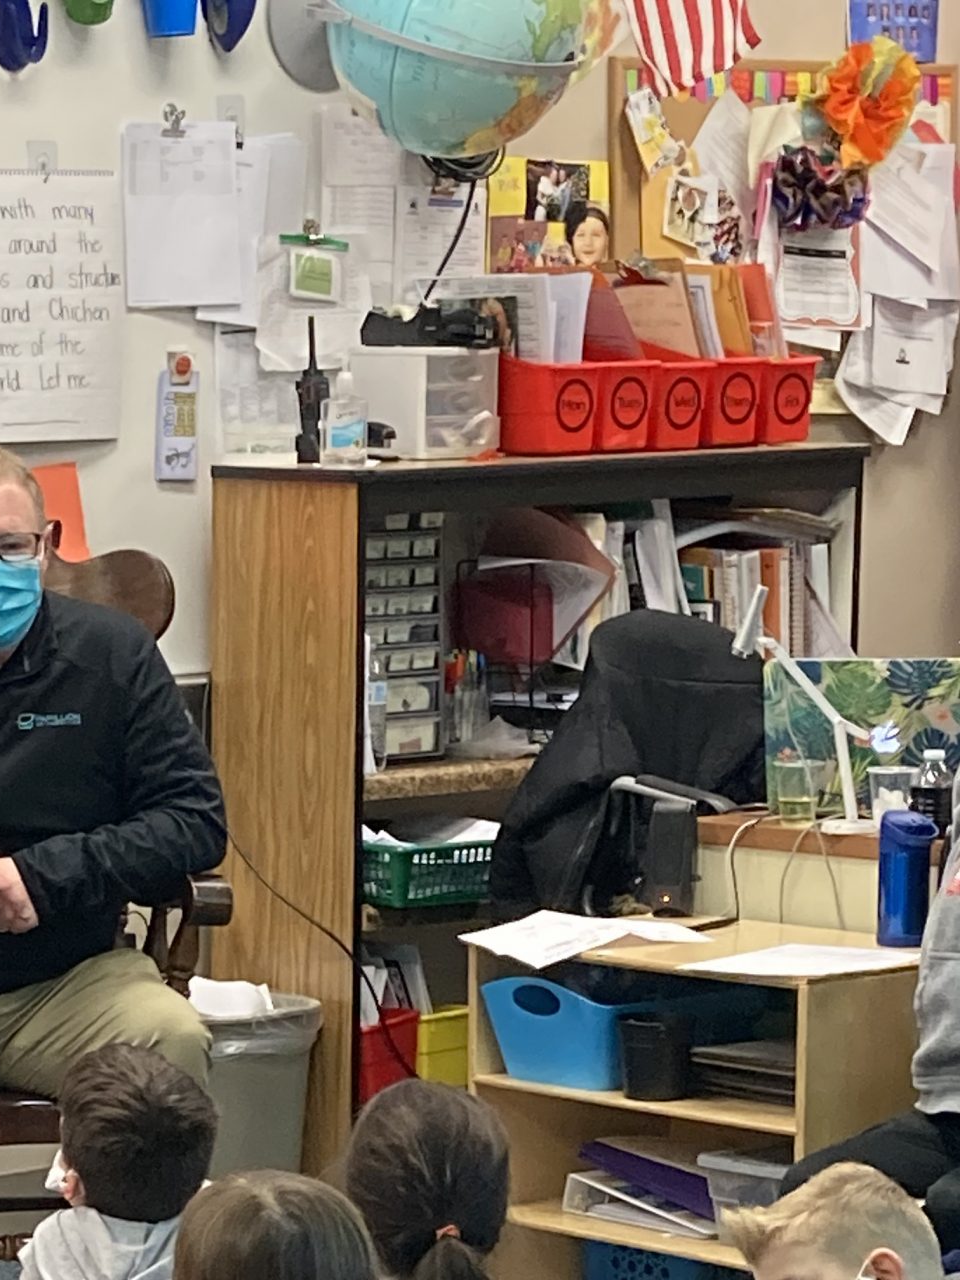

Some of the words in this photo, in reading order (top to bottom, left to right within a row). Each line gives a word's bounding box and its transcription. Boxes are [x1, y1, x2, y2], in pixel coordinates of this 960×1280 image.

[0, 198, 36, 220] with
[52, 205, 94, 225] many
[9, 232, 57, 255] around
[78, 231, 103, 253] the
[26, 265, 54, 290] and
[1, 300, 30, 324] and
[31, 331, 46, 357] of
[56, 333, 85, 356] the
[39, 362, 60, 391] Let
[67, 373, 90, 390] me
